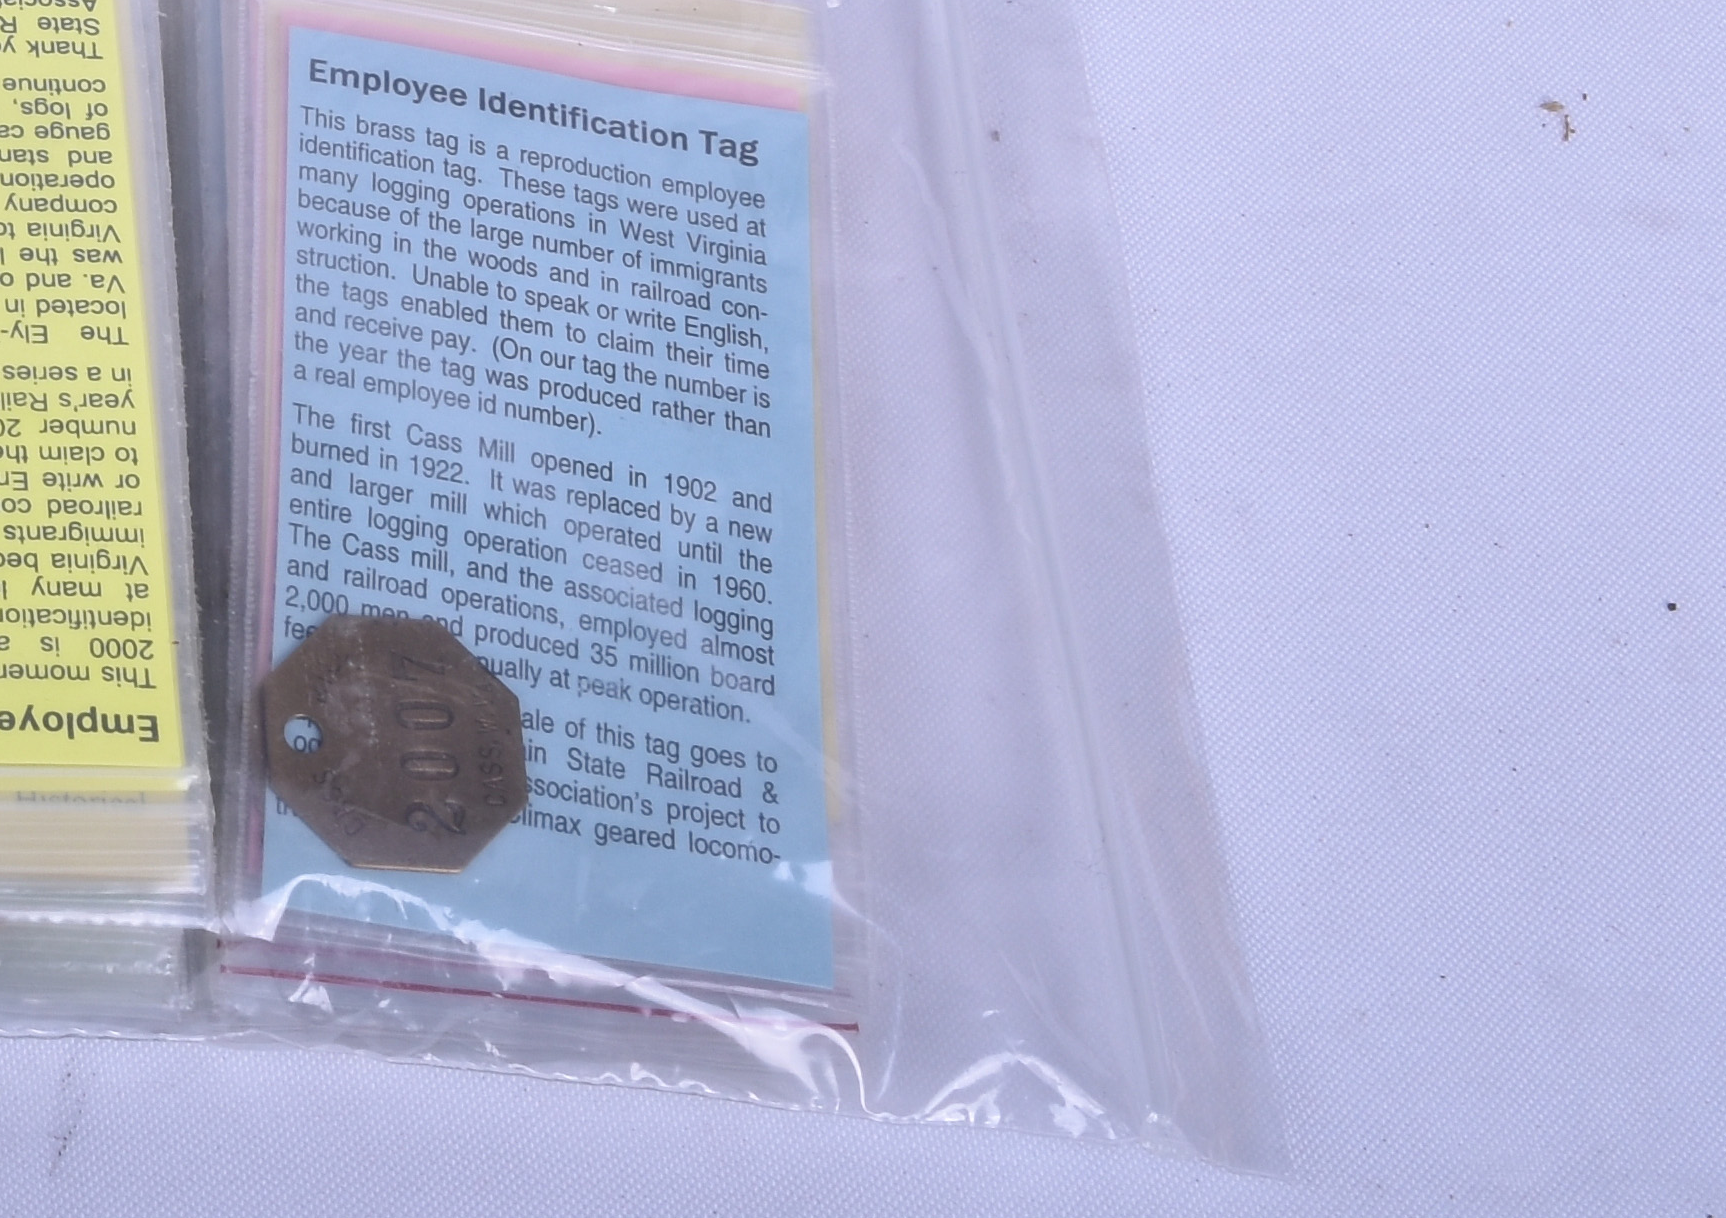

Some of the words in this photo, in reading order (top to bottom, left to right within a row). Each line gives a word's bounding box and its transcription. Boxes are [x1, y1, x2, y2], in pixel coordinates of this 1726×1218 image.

[24, 38, 104, 60] Thank
[308, 57, 468, 107] Employee
[477, 86, 688, 152] Identification
[697, 128, 759, 167] Tag
[298, 131, 435, 174] identification
[442, 156, 483, 187] tag.
[497, 165, 566, 199] These
[572, 182, 619, 213] tags
[625, 196, 678, 222] were
[686, 208, 738, 233] used
[745, 217, 766, 238] at
[299, 103, 346, 131] This
[355, 113, 416, 143] brass
[424, 125, 459, 156] tag
[468, 132, 486, 156] is
[495, 143, 510, 161] a
[519, 147, 652, 189] reproduction
[660, 176, 766, 210] employee
[3, 297, 26, 318] in
[34, 297, 127, 320] located
[291, 401, 335, 430] The
[349, 411, 391, 441] first
[405, 422, 463, 454] Cass
[477, 435, 515, 464] Mill
[529, 450, 613, 483] opened
[627, 463, 647, 489] in
[663, 471, 717, 503] 1902
[731, 489, 772, 514] and
[100, 664, 157, 690] This
